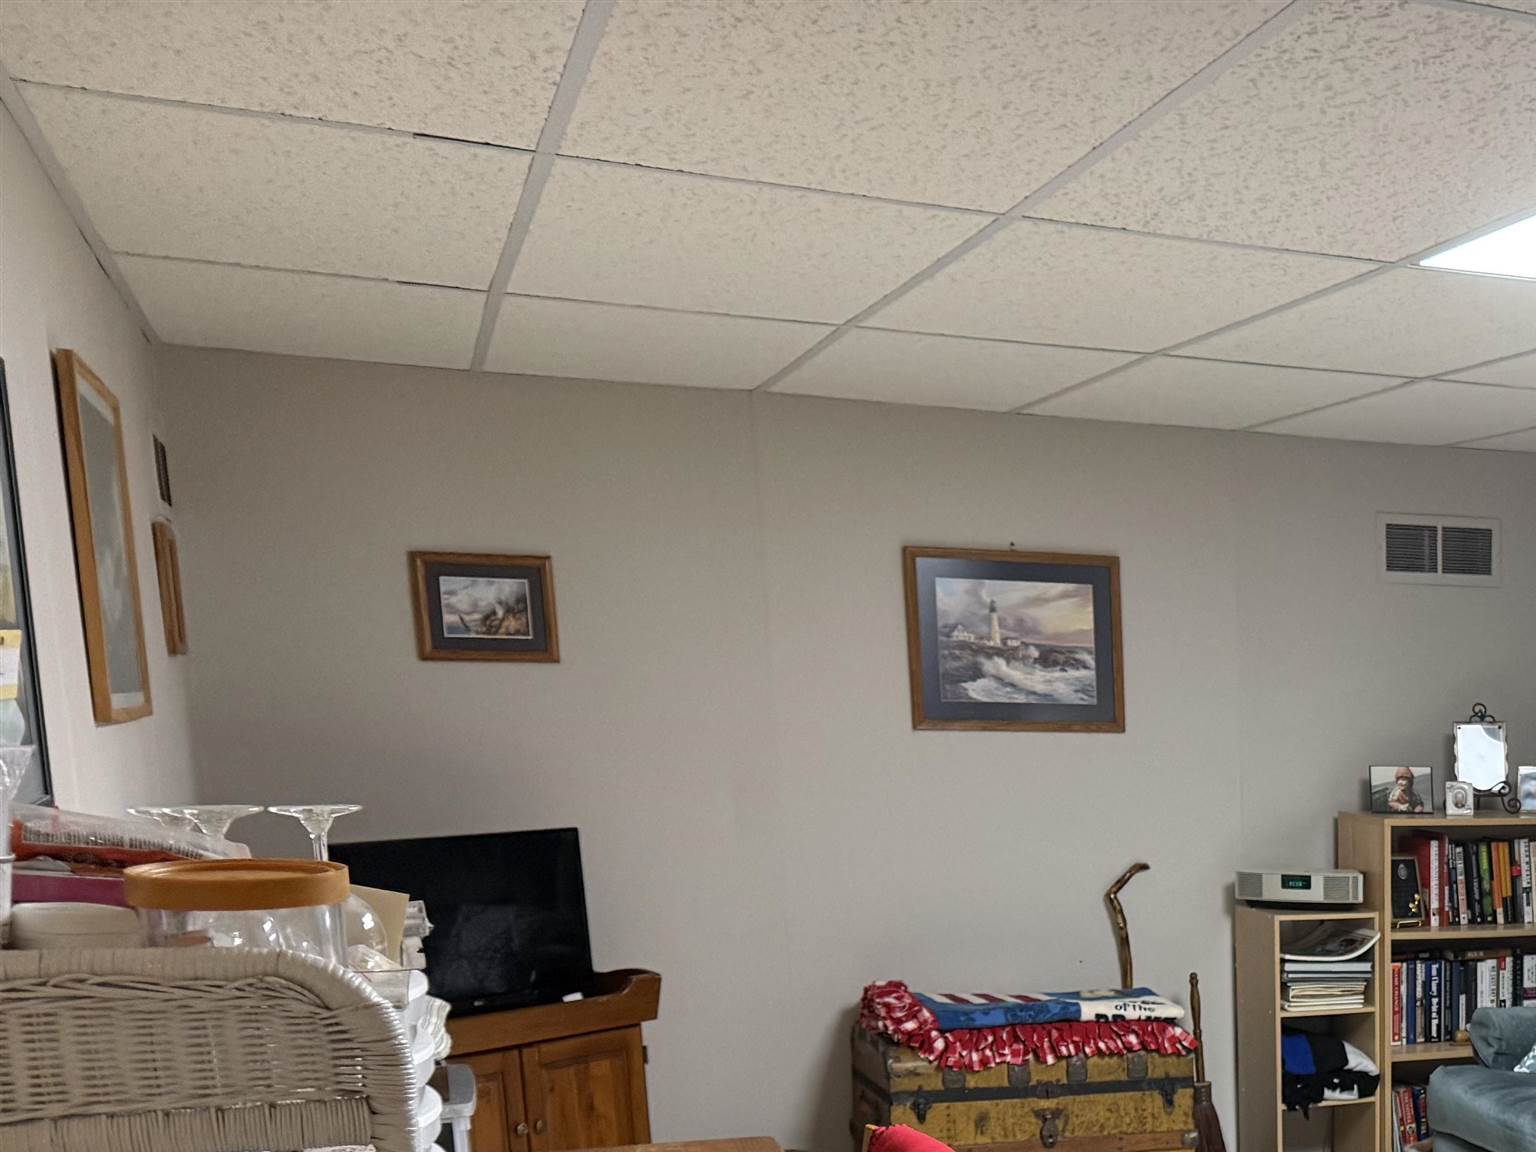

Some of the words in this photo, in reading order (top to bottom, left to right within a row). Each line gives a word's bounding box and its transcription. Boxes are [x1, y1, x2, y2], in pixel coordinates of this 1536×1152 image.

[1431, 964, 1439, 976] Tom
[1429, 977, 1439, 996] Clancy
[1114, 1002, 1128, 1012] of
[1132, 1004, 1156, 1012] the
[1431, 997, 1439, 1012] Debt
[1431, 1019, 1439, 1038] Honor
